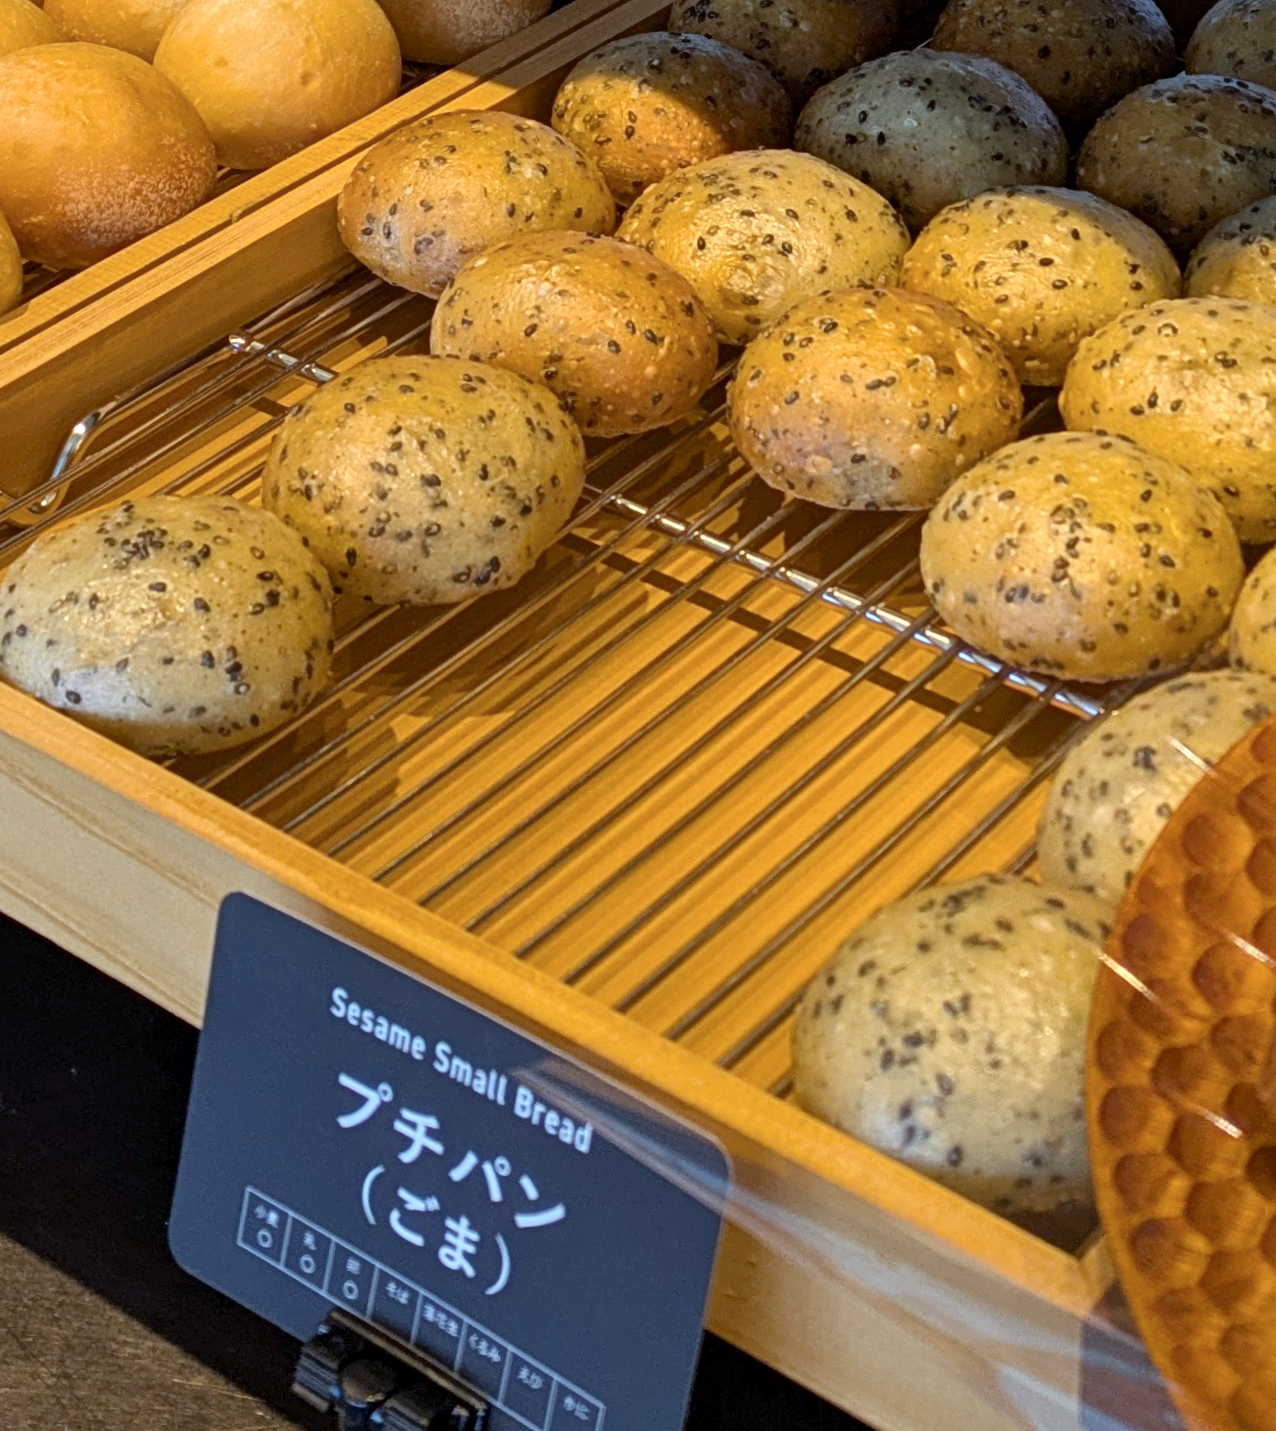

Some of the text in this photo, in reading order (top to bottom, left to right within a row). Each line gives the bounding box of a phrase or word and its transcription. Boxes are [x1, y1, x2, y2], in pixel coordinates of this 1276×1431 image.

[330, 987, 594, 1154] Sesame Small Bread
[336, 1071, 567, 1229] プチパン
